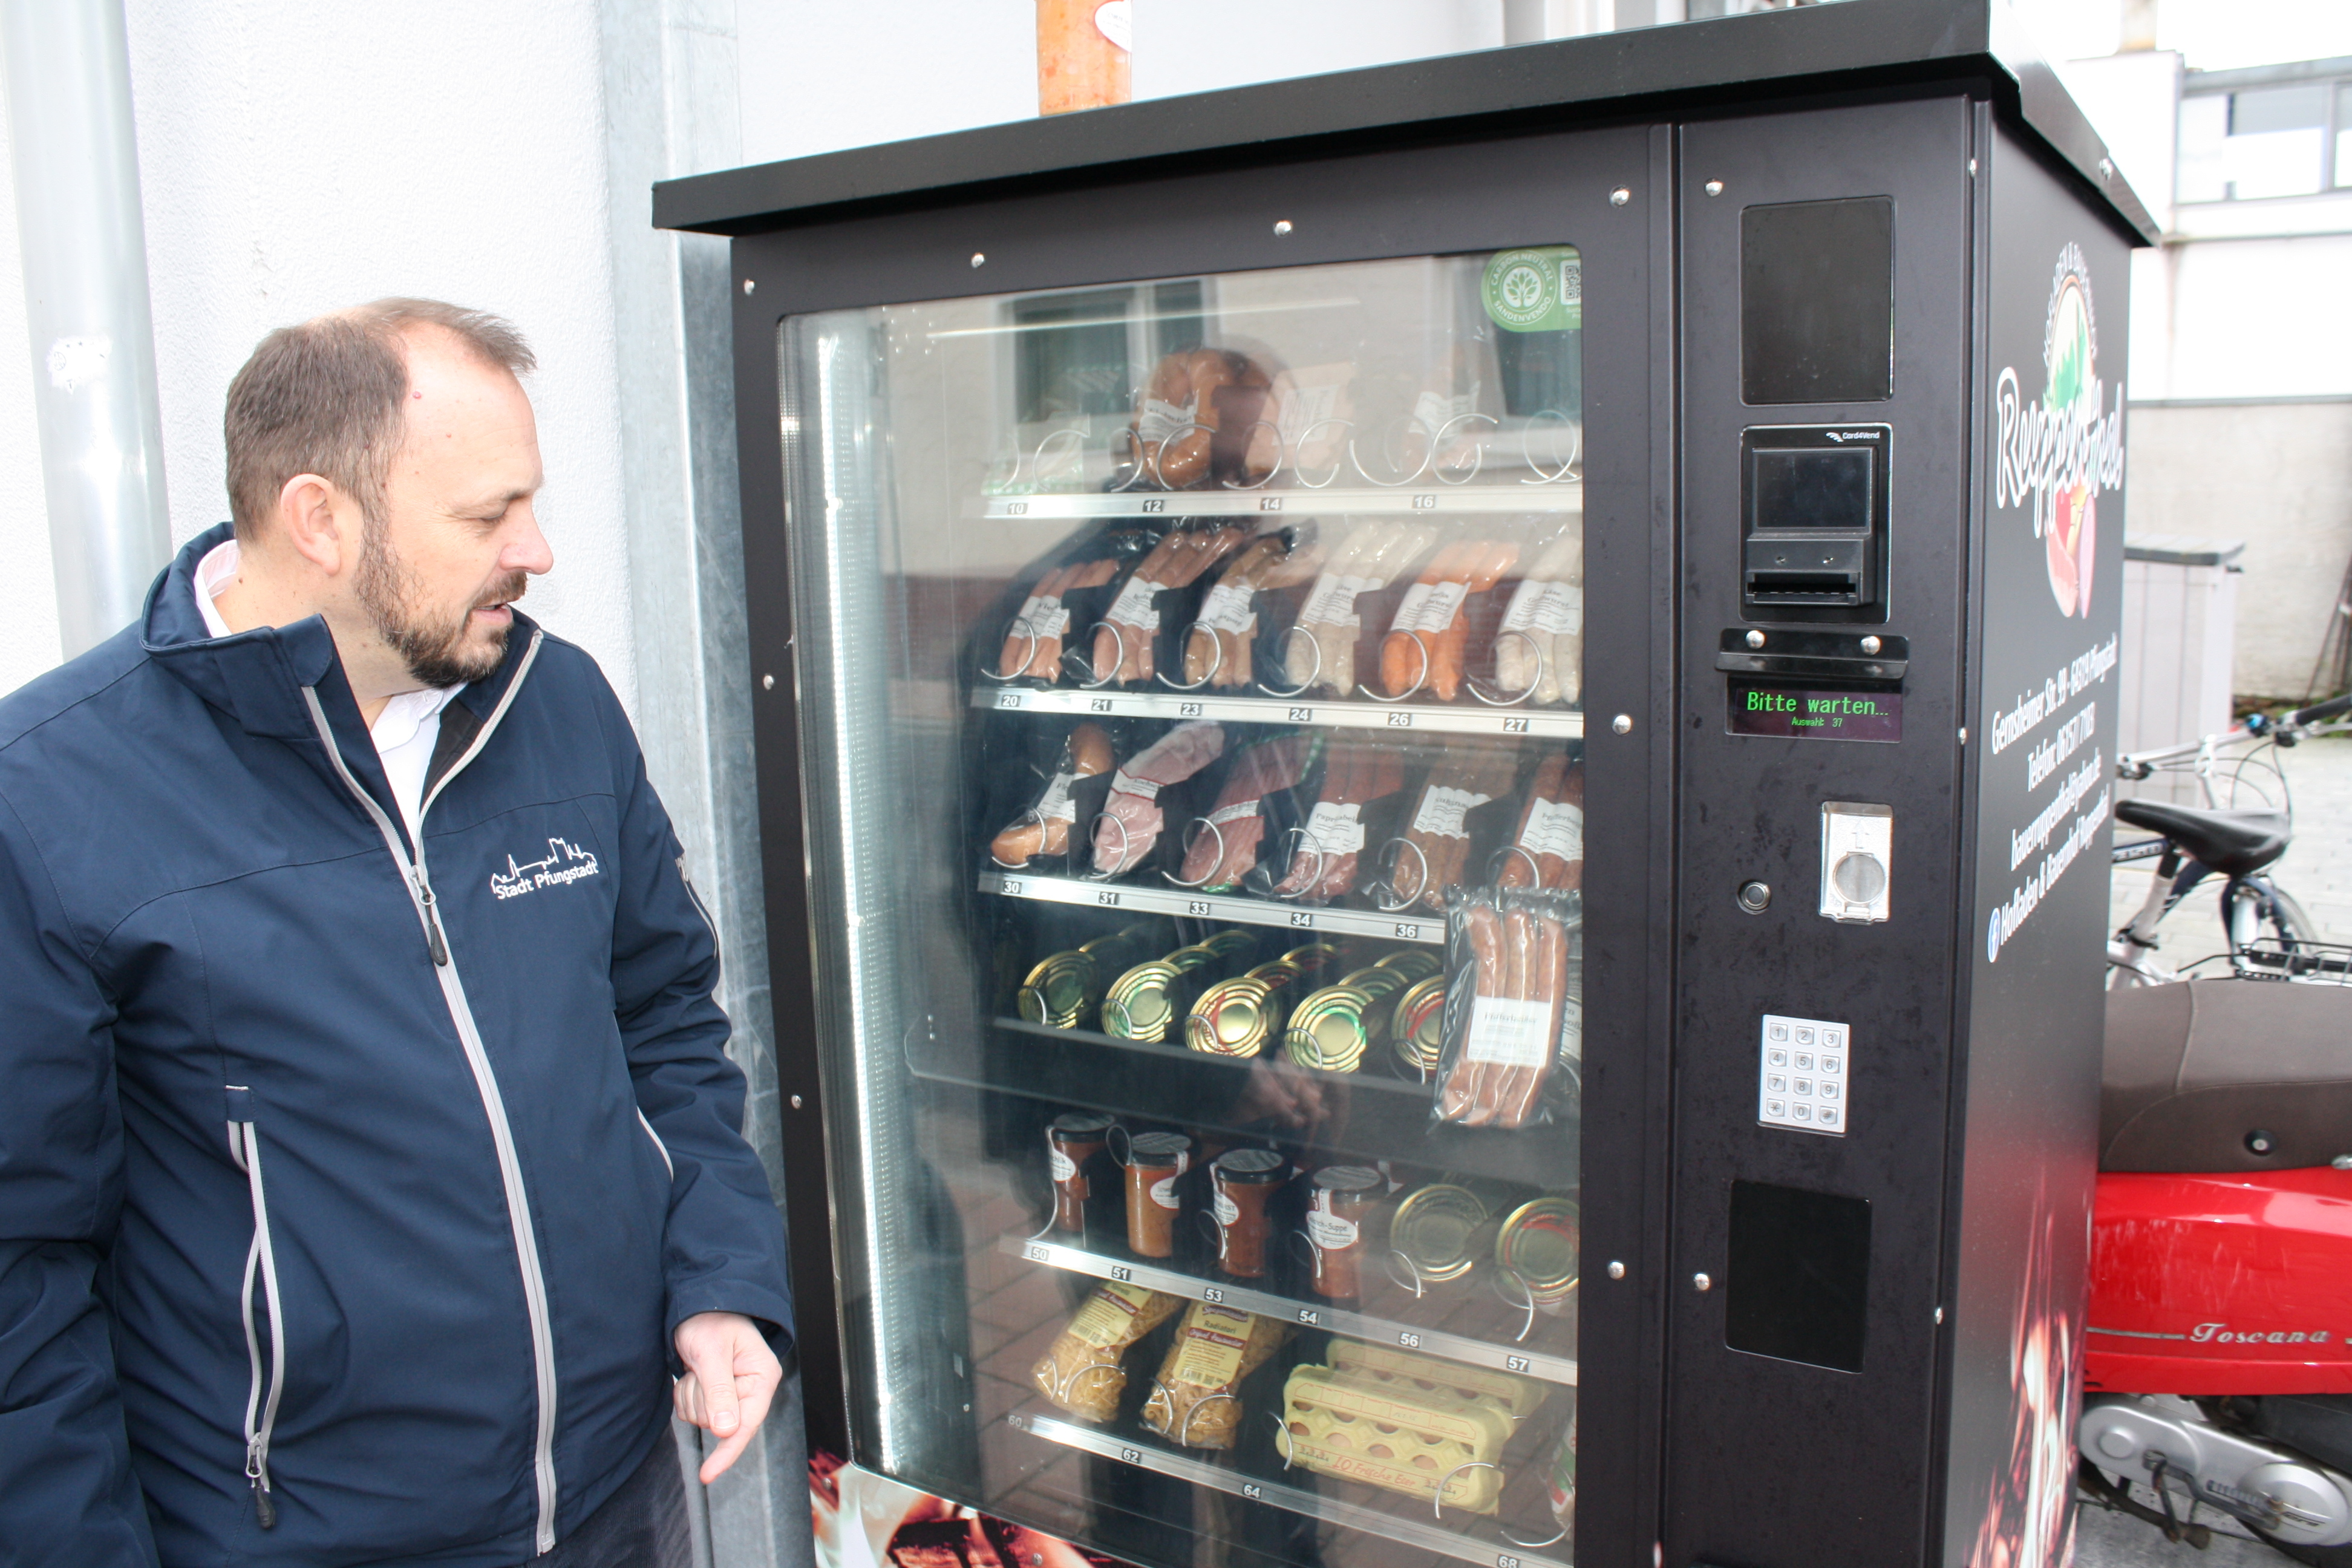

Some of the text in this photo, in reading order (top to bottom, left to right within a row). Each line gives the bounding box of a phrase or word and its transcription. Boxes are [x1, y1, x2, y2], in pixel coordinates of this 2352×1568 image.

[1491, 253, 1553, 286] CARBON NEUTRAL
[1494, 296, 1551, 322] SANDENVENDO
[1145, 501, 1161, 512] 12
[1263, 498, 1280, 510] 14
[1414, 496, 1433, 508] 16
[1008, 503, 1024, 514] 10
[1002, 696, 1018, 706] 20
[1093, 701, 1108, 711] 21
[1747, 691, 1797, 711] Bitte
[1182, 705, 1199, 716] 23
[1290, 709, 1309, 721] 24
[1390, 714, 1410, 726] 26
[1506, 719, 1526, 732] 27
[1832, 717, 1843, 727] 37
[495, 860, 599, 900] Stadt Pfungstadt
[1004, 883, 1020, 893] 30
[1100, 893, 1116, 904] 31
[1192, 903, 1208, 914] 33
[1292, 913, 1310, 926] 34
[1397, 924, 1416, 937] 36
[1032, 1249, 1047, 1260] 50
[1113, 1267, 1129, 1279] 51
[1206, 1289, 1223, 1301] 53
[1299, 1311, 1317, 1324] 54
[2189, 1322, 2330, 1344] Toscana
[1400, 1333, 1419, 1346] 56
[1509, 1357, 1527, 1370] 57
[1008, 1415, 1022, 1426] 60
[1123, 1450, 1138, 1462] 62
[1244, 1485, 1259, 1497] 64
[1498, 1555, 1518, 1568] 68
